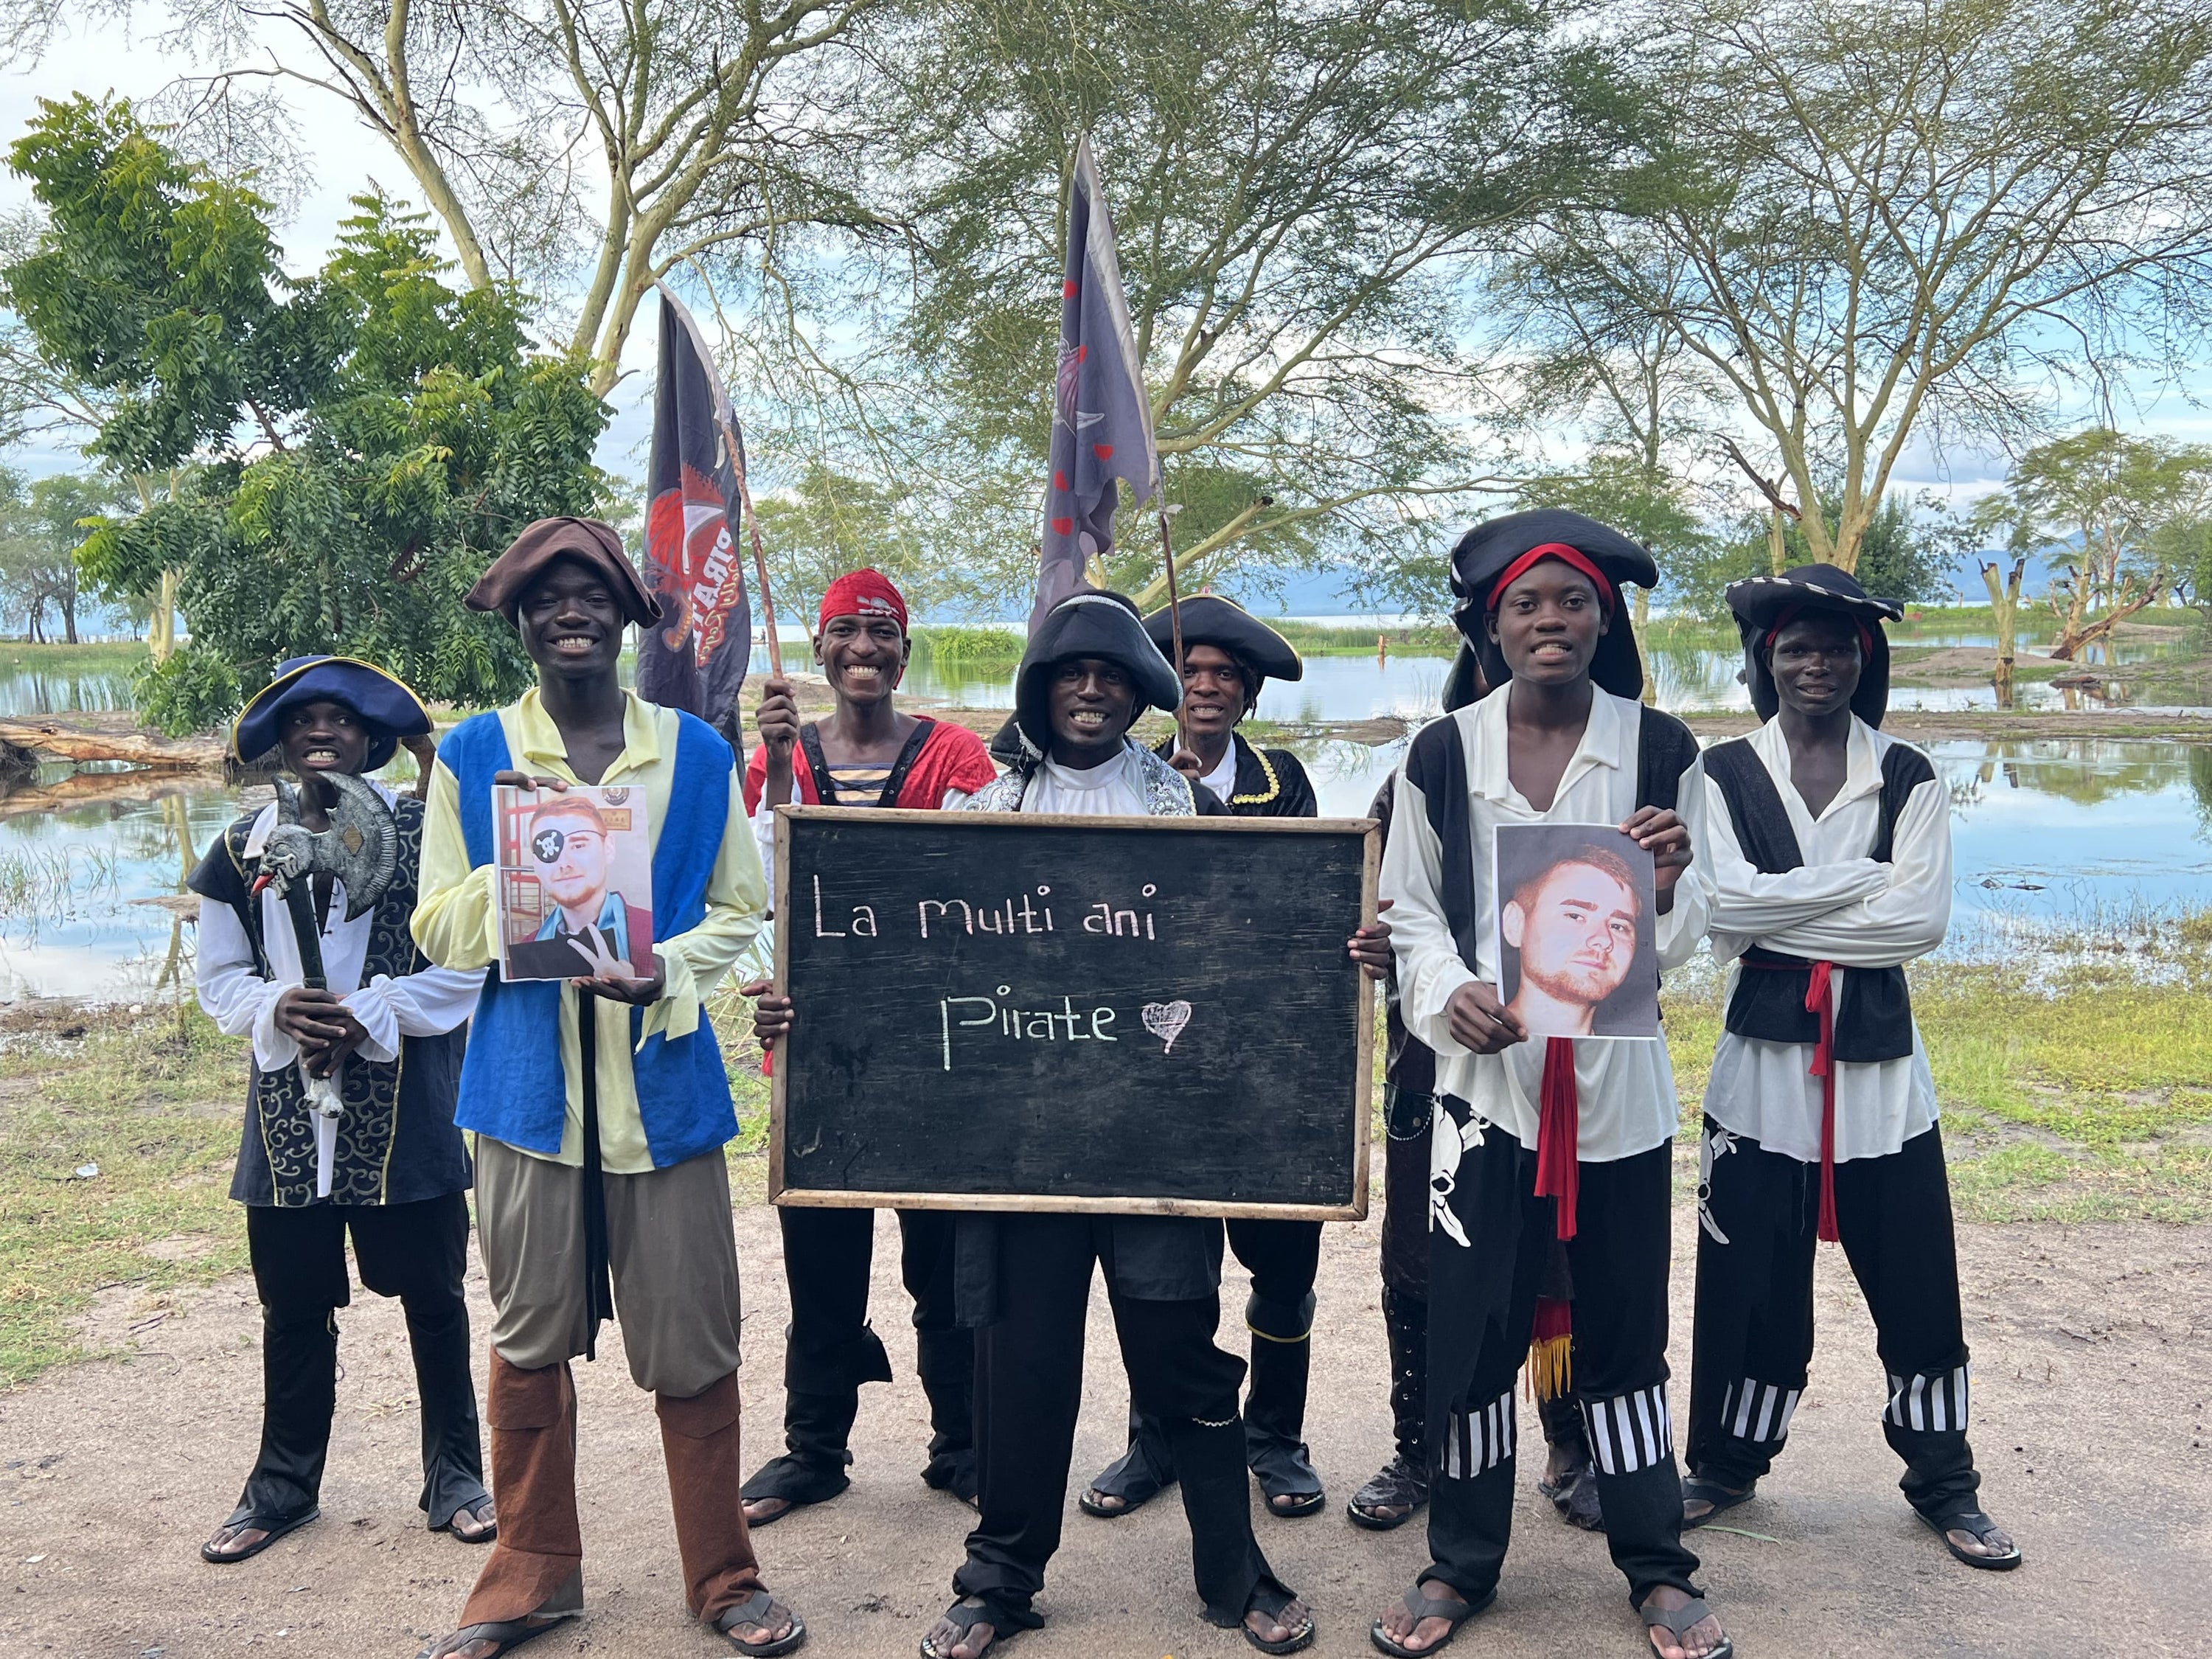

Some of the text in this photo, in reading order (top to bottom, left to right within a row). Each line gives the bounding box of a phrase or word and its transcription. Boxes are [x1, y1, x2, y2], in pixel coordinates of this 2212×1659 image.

[813, 874, 877, 937] La
[1083, 883, 1157, 940] ani
[940, 984, 1118, 1071] Pirate
